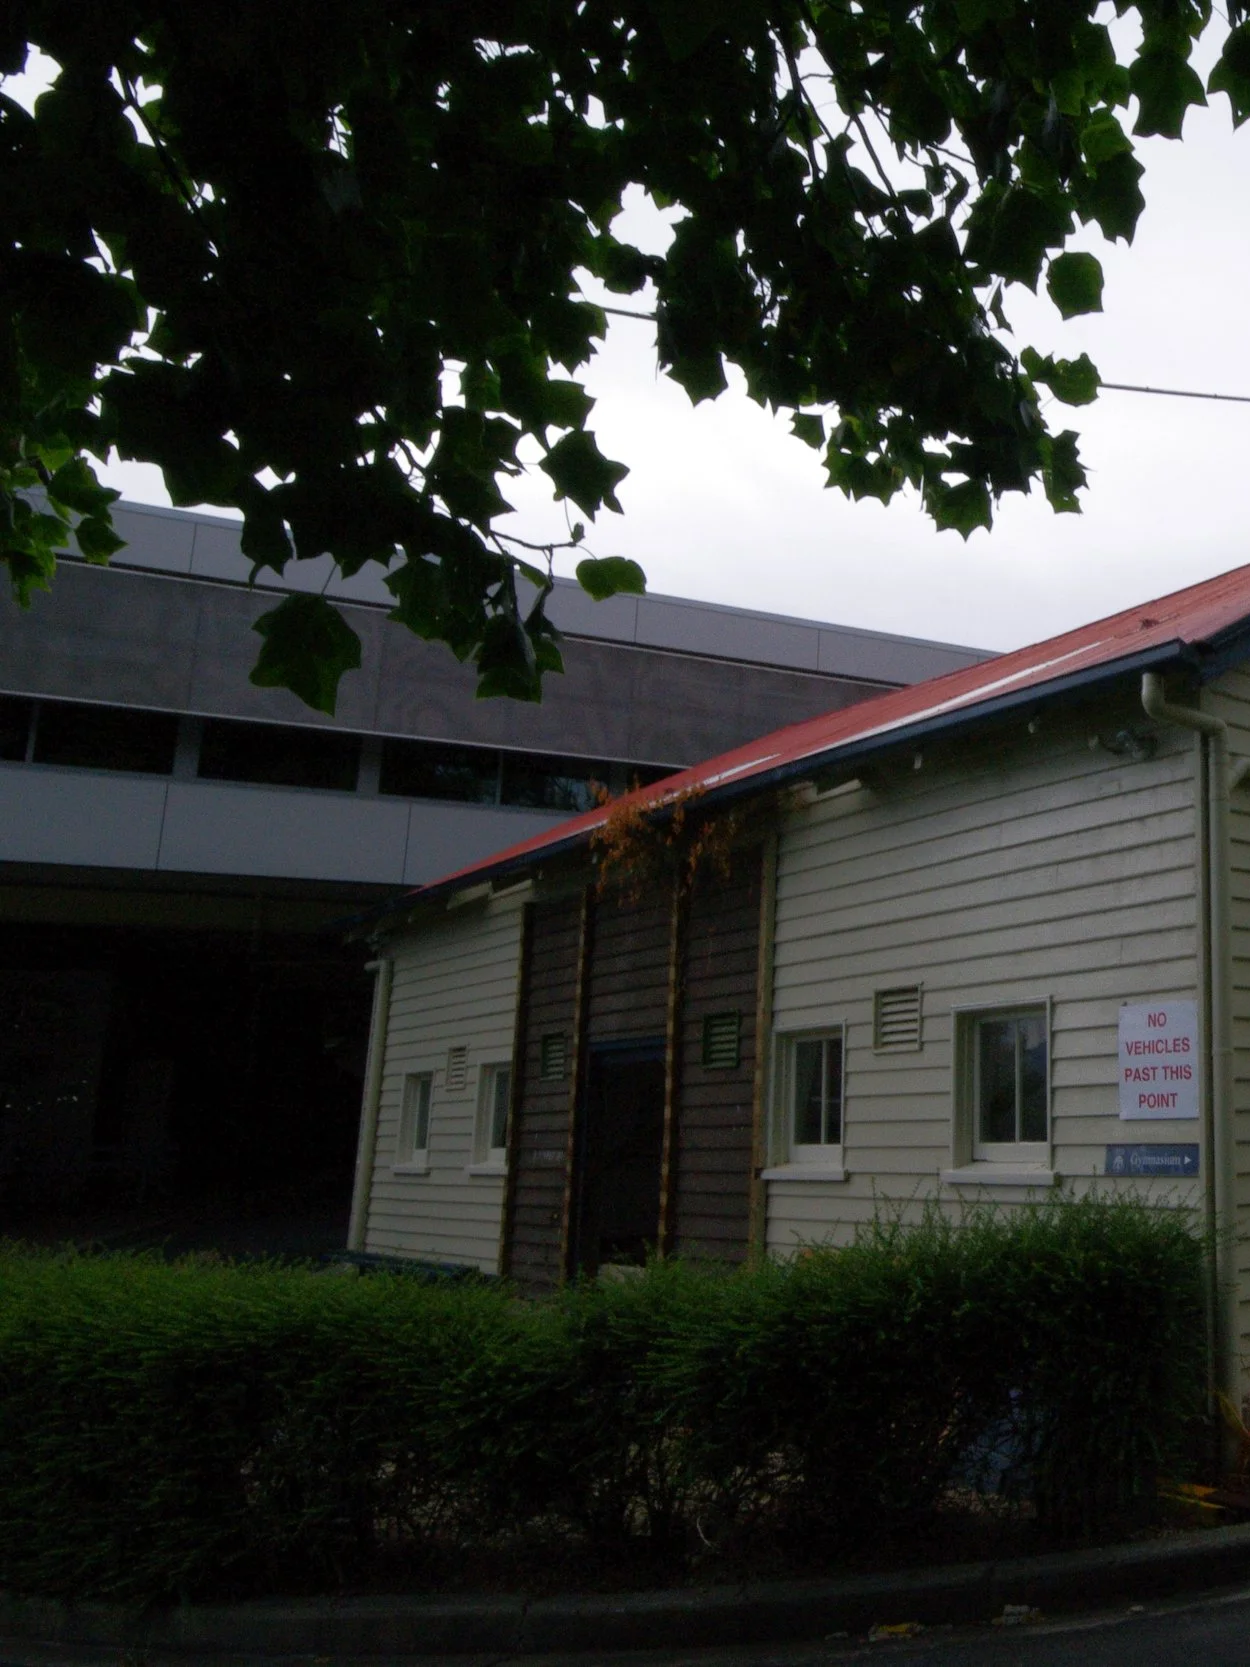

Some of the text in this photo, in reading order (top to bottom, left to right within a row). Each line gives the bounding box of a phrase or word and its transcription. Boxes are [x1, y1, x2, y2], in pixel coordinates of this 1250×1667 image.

[1147, 1012, 1167, 1028] NO
[1126, 1037, 1191, 1056] VEHICLES
[1124, 1064, 1192, 1082] PAST THIS
[1138, 1092, 1178, 1109] POINT
